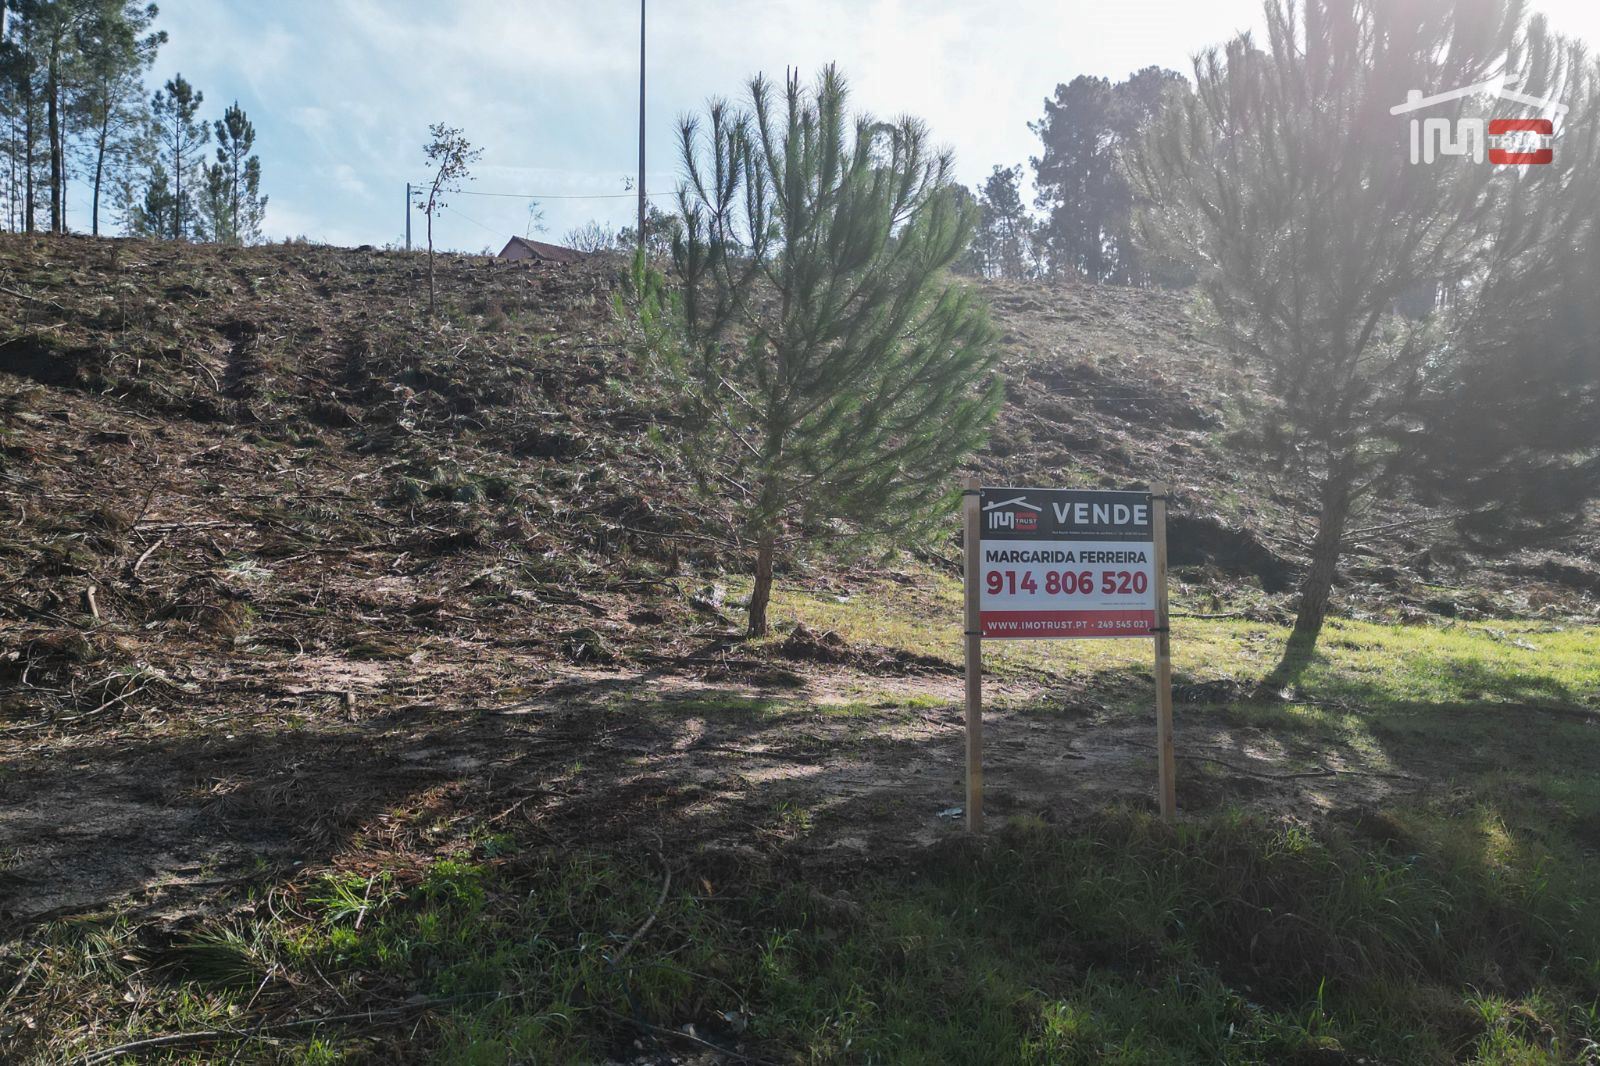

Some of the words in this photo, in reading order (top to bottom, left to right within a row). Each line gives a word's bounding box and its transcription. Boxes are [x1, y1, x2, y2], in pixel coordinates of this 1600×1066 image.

[1052, 502, 1148, 526] VENDE
[986, 550, 1076, 564] MARGARIDA
[1080, 550, 1147, 564] FERREIRA
[986, 570, 1038, 595] 914
[1045, 570, 1094, 595] 806
[1101, 571, 1148, 595] 520
[987, 620, 1088, 630] WWW.IMOTRUST.PT
[1097, 620, 1113, 629] 249
[1116, 620, 1131, 629] 545
[1133, 620, 1148, 628] 021
